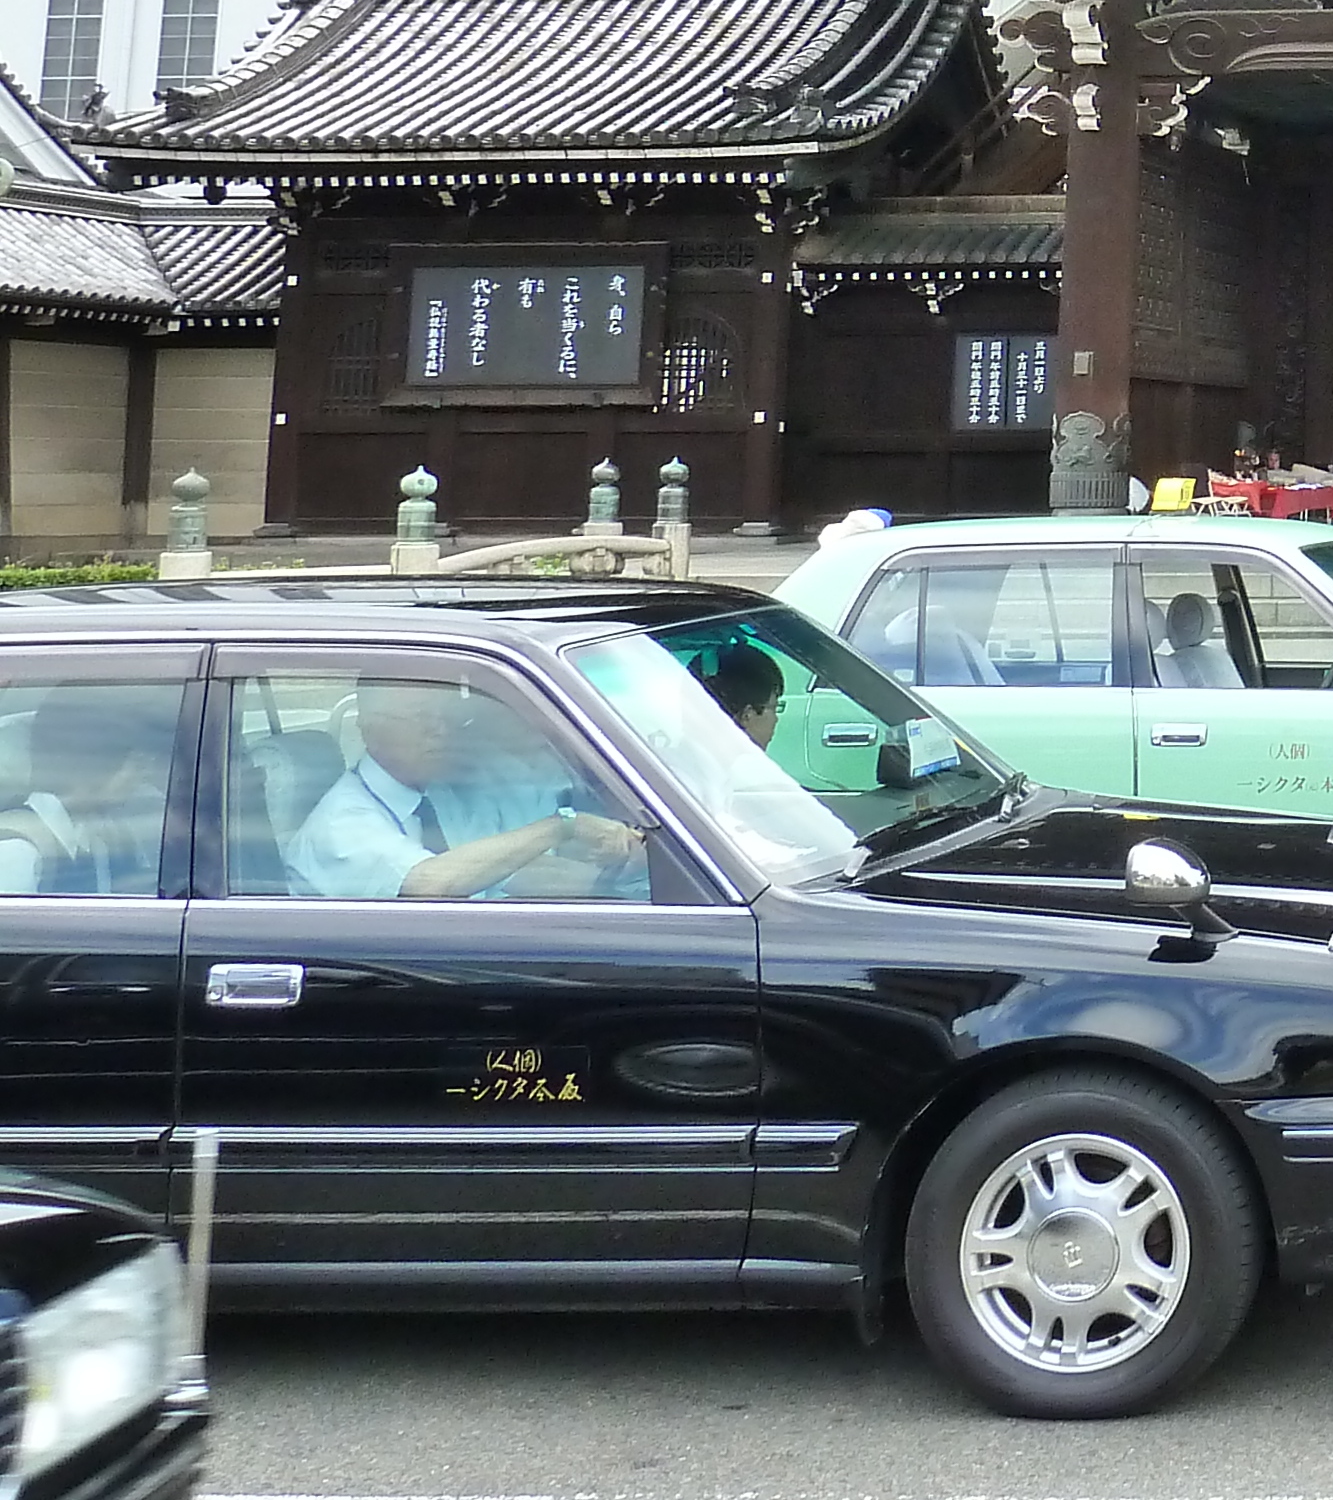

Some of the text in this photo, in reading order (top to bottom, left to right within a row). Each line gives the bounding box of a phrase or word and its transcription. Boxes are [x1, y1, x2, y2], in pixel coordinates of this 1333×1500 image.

[468, 277, 492, 367] 代わる者なし
